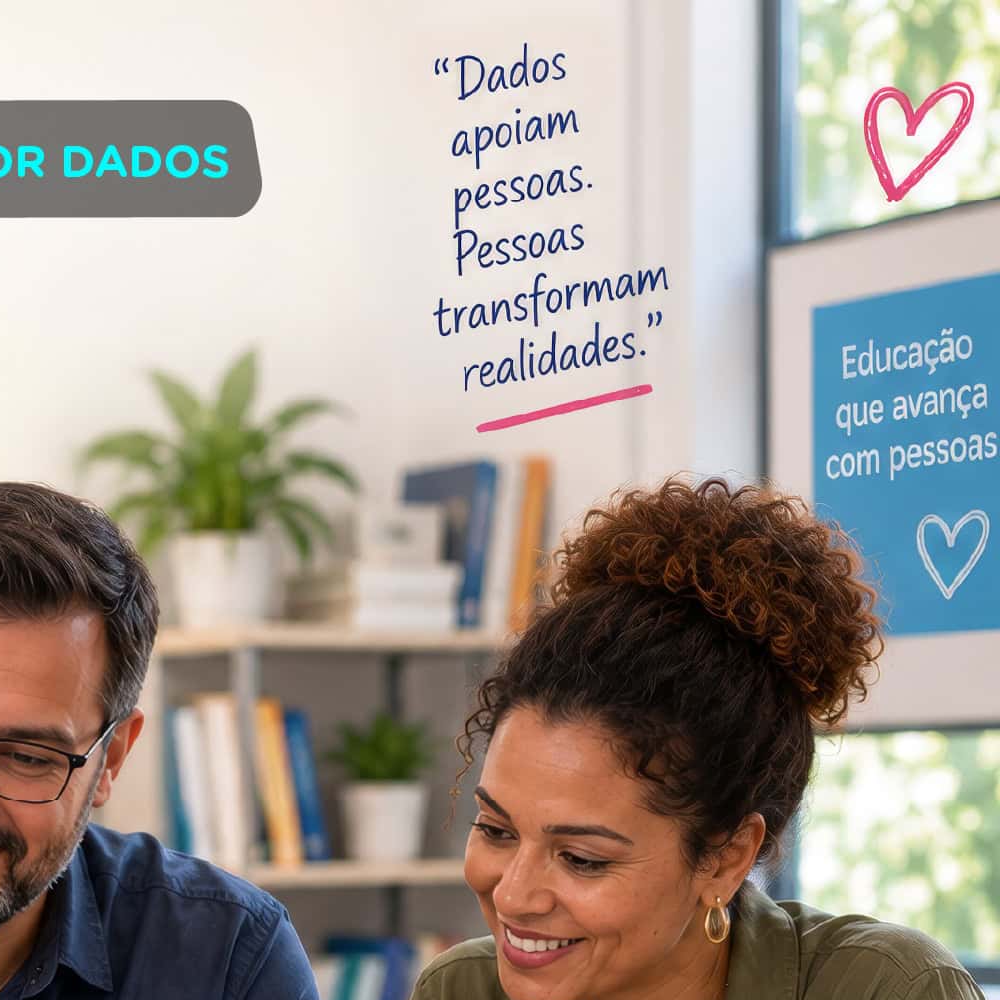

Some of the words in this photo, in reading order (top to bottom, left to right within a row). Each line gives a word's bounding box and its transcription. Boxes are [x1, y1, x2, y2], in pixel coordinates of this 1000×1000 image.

[842, 327, 973, 380] Educação
[835, 398, 884, 435] que
[892, 381, 988, 422] avança
[825, 446, 881, 480] com
[890, 430, 998, 480] pessoas
